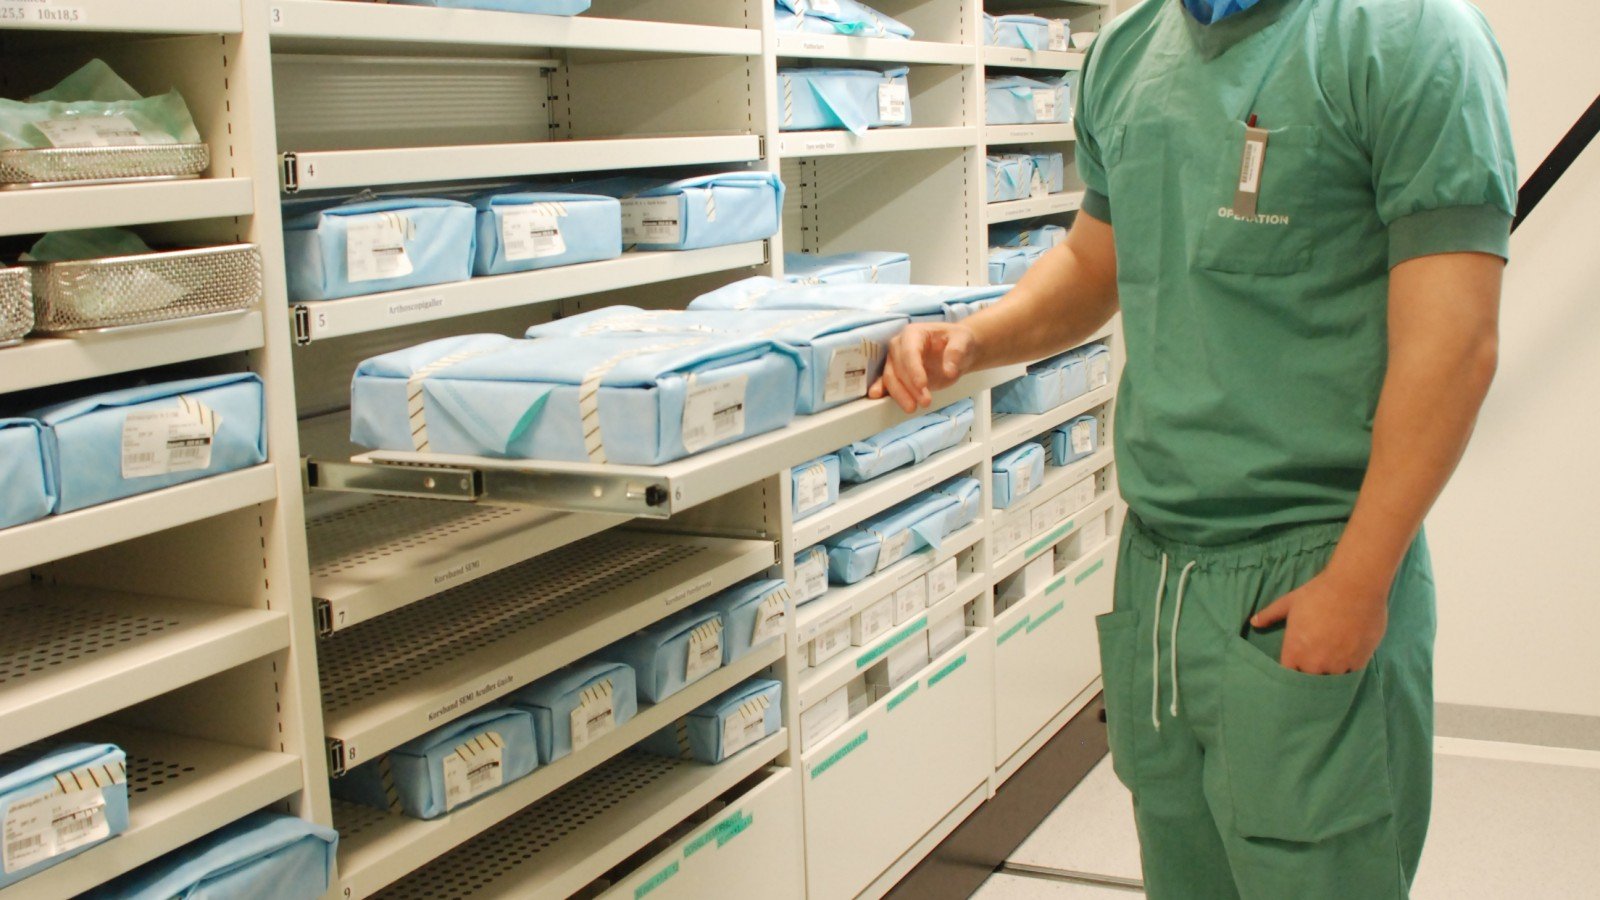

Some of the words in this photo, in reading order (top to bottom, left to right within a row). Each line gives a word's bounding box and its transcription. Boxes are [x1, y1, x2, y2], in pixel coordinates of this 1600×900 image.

[38, 9, 79, 21] 10x18,5
[273, 8, 280, 22] 3
[307, 164, 315, 177] 4
[319, 314, 326, 328] 5
[675, 485, 682, 501] 6
[338, 610, 346, 625] 7
[428, 699, 459, 721] Korsband
[458, 691, 475, 706] SEMI
[349, 746, 357, 761] 8
[343, 886, 352, 898] 9
